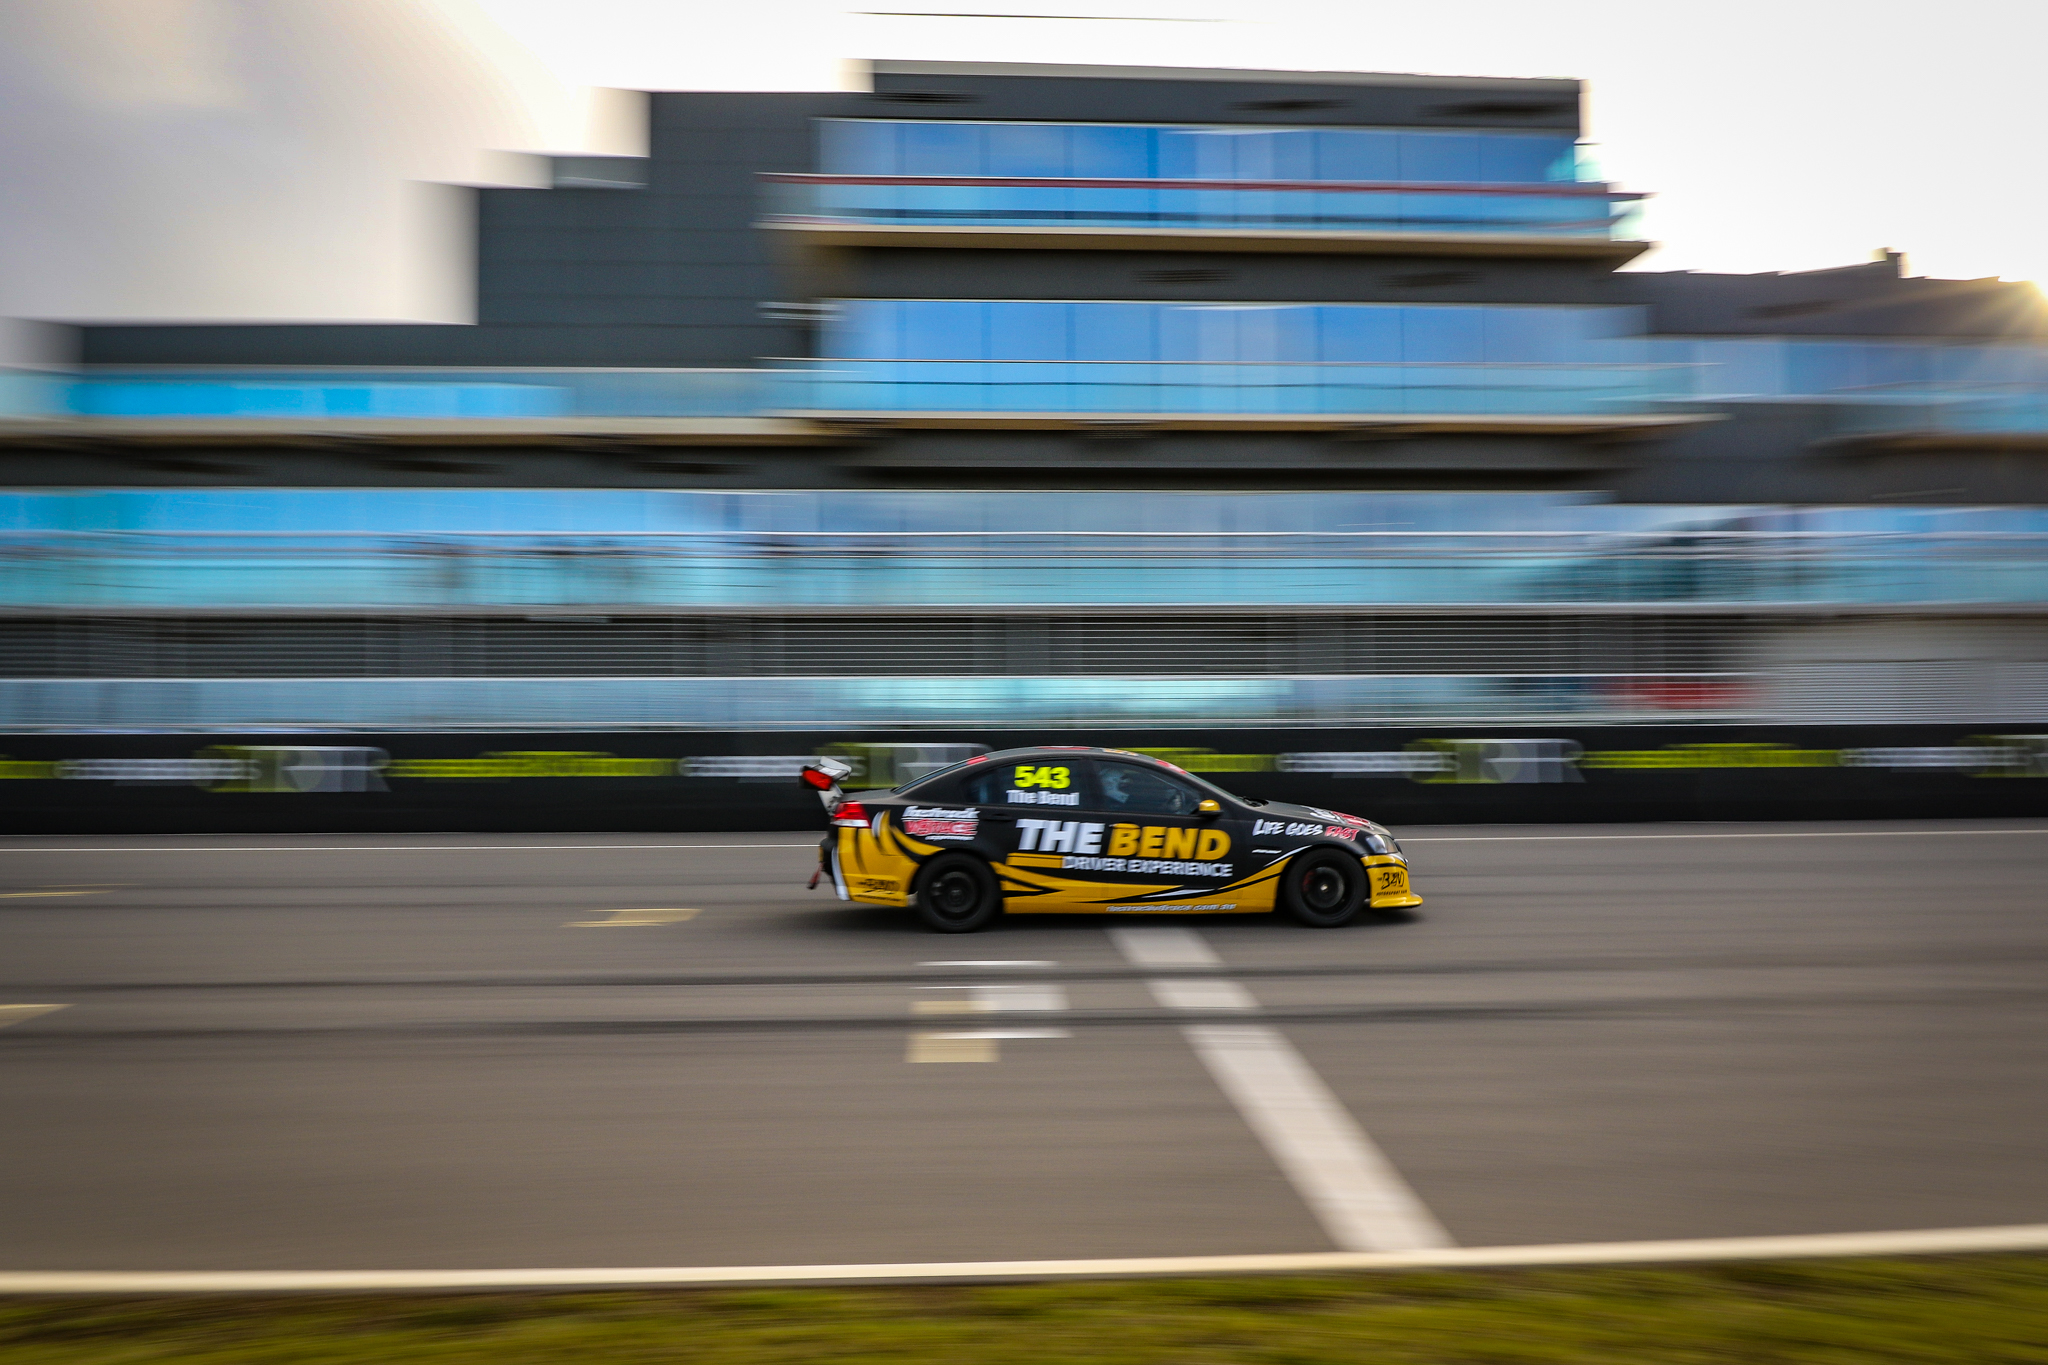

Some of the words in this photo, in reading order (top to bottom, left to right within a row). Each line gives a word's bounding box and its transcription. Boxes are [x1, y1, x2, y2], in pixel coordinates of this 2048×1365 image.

[1014, 766, 1071, 789] 543
[1006, 789, 1037, 804] The
[1037, 791, 1080, 806] Bend
[1015, 818, 1105, 854] THE
[1107, 822, 1232, 861] BEND
[1062, 856, 1127, 873] DRIVER
[1127, 859, 1233, 877] EXPERIENCE
